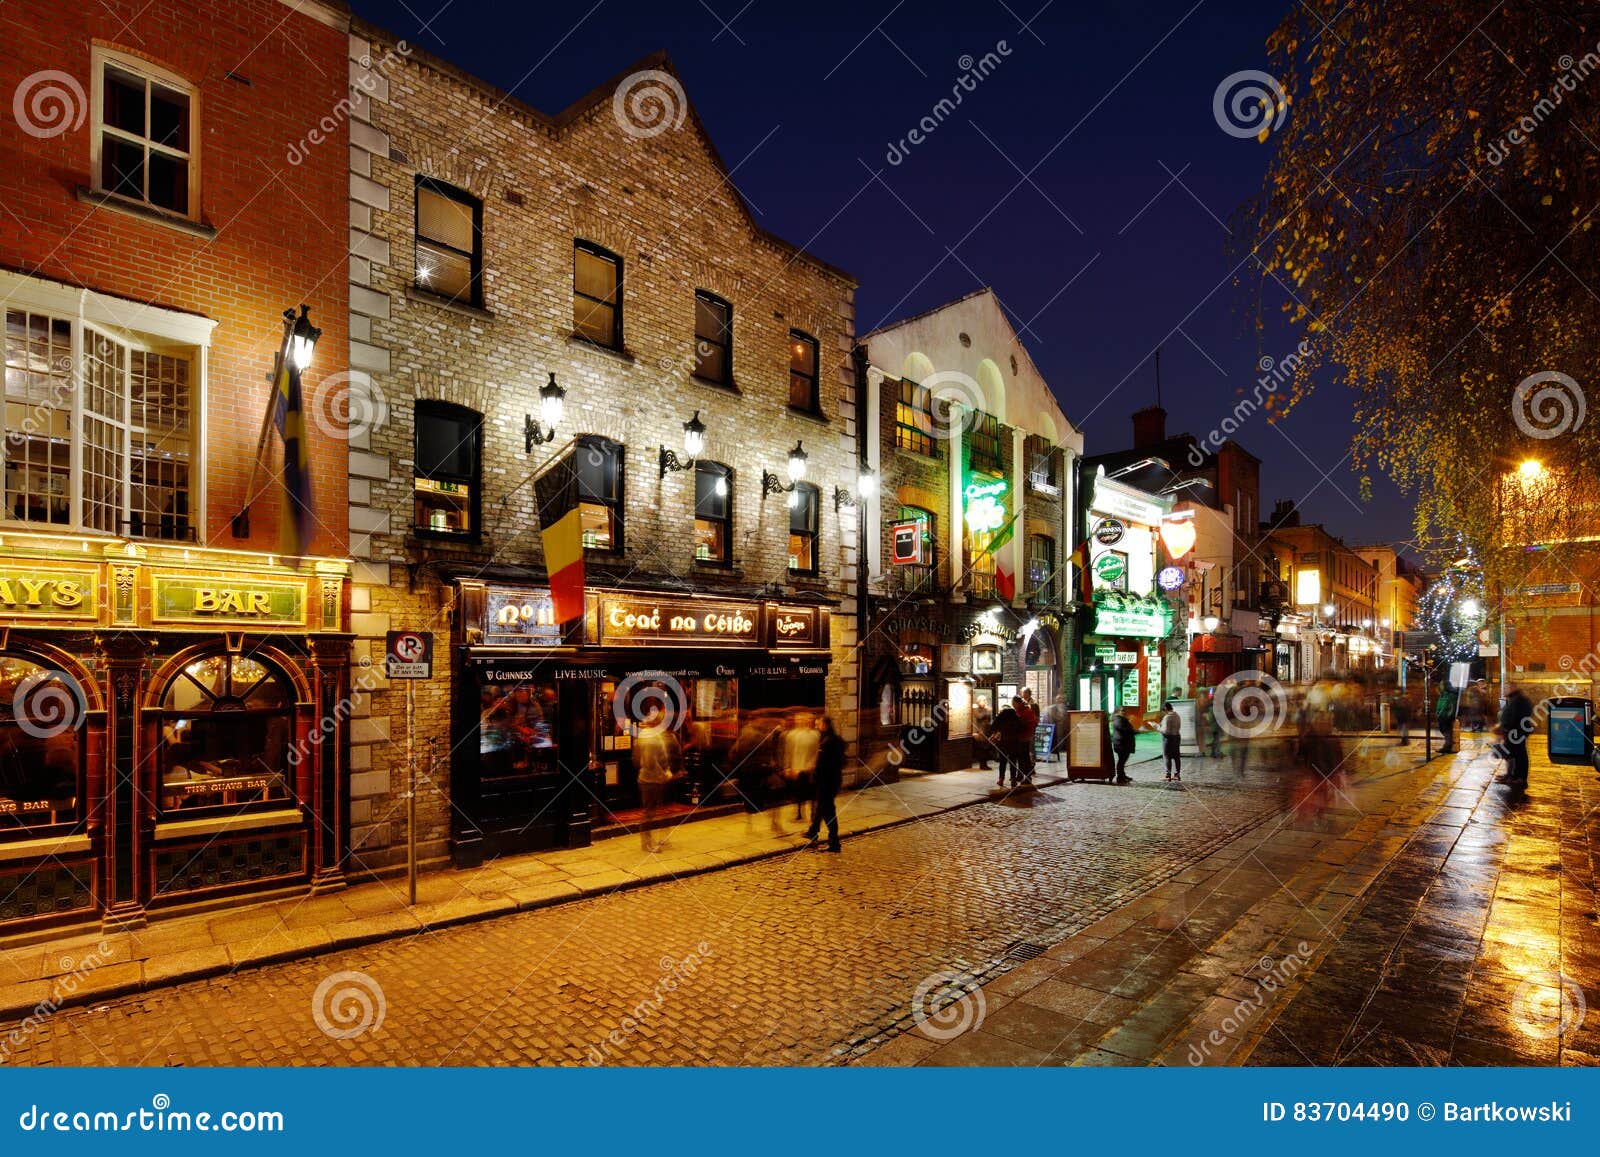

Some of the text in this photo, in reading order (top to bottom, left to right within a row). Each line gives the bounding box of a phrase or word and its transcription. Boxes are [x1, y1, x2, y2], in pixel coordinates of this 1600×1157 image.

[194, 588, 272, 615] BAR
[670, 617, 696, 631] na
[495, 670, 533, 681] GUINNESS
[555, 669, 607, 679] LIVE MUSIC
[749, 667, 766, 676] LATE
[772, 667, 787, 675] LIVE
[184, 784, 207, 794] THE
[247, 779, 267, 788] BAR
[0, 800, 49, 812] YS BAR
